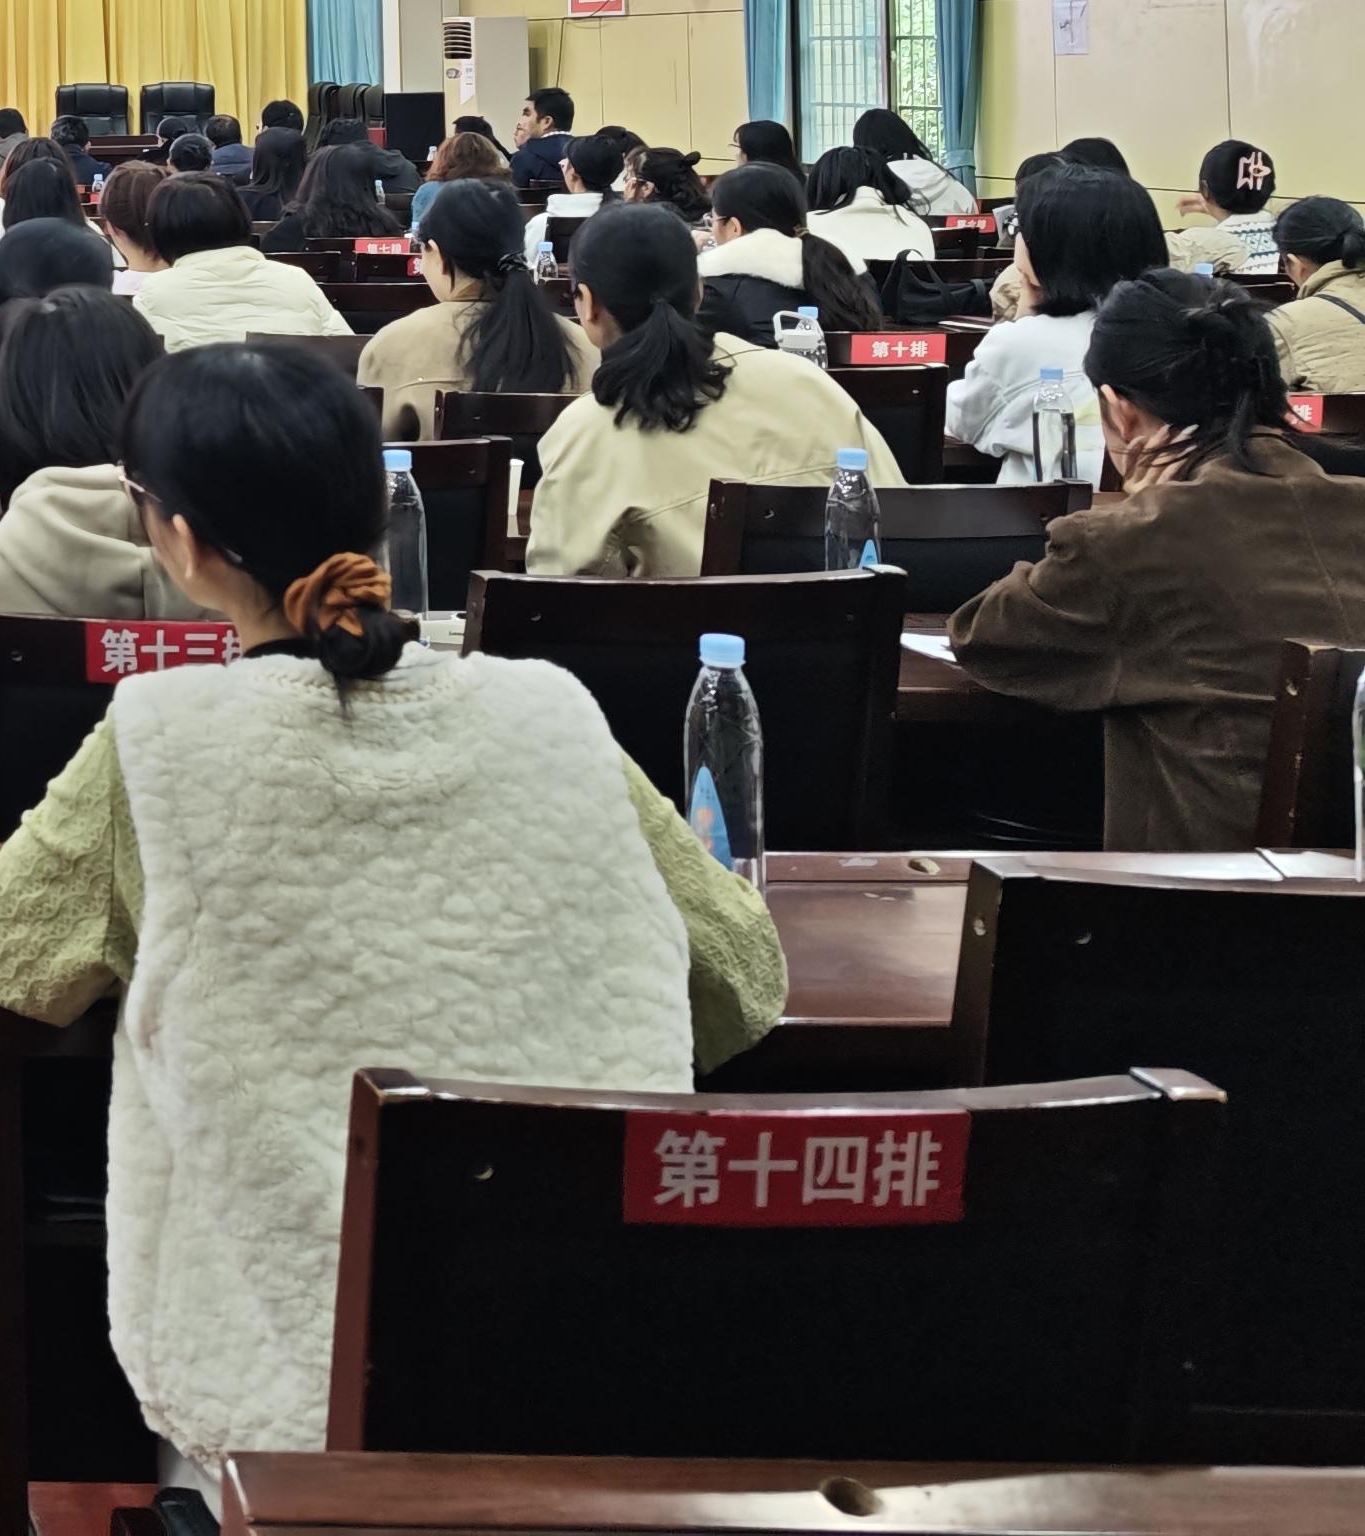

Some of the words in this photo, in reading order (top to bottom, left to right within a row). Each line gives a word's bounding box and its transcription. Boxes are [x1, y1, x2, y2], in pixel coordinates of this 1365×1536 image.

[871, 340, 929, 358] 第十排
[653, 1129, 942, 1208] 第十四排
